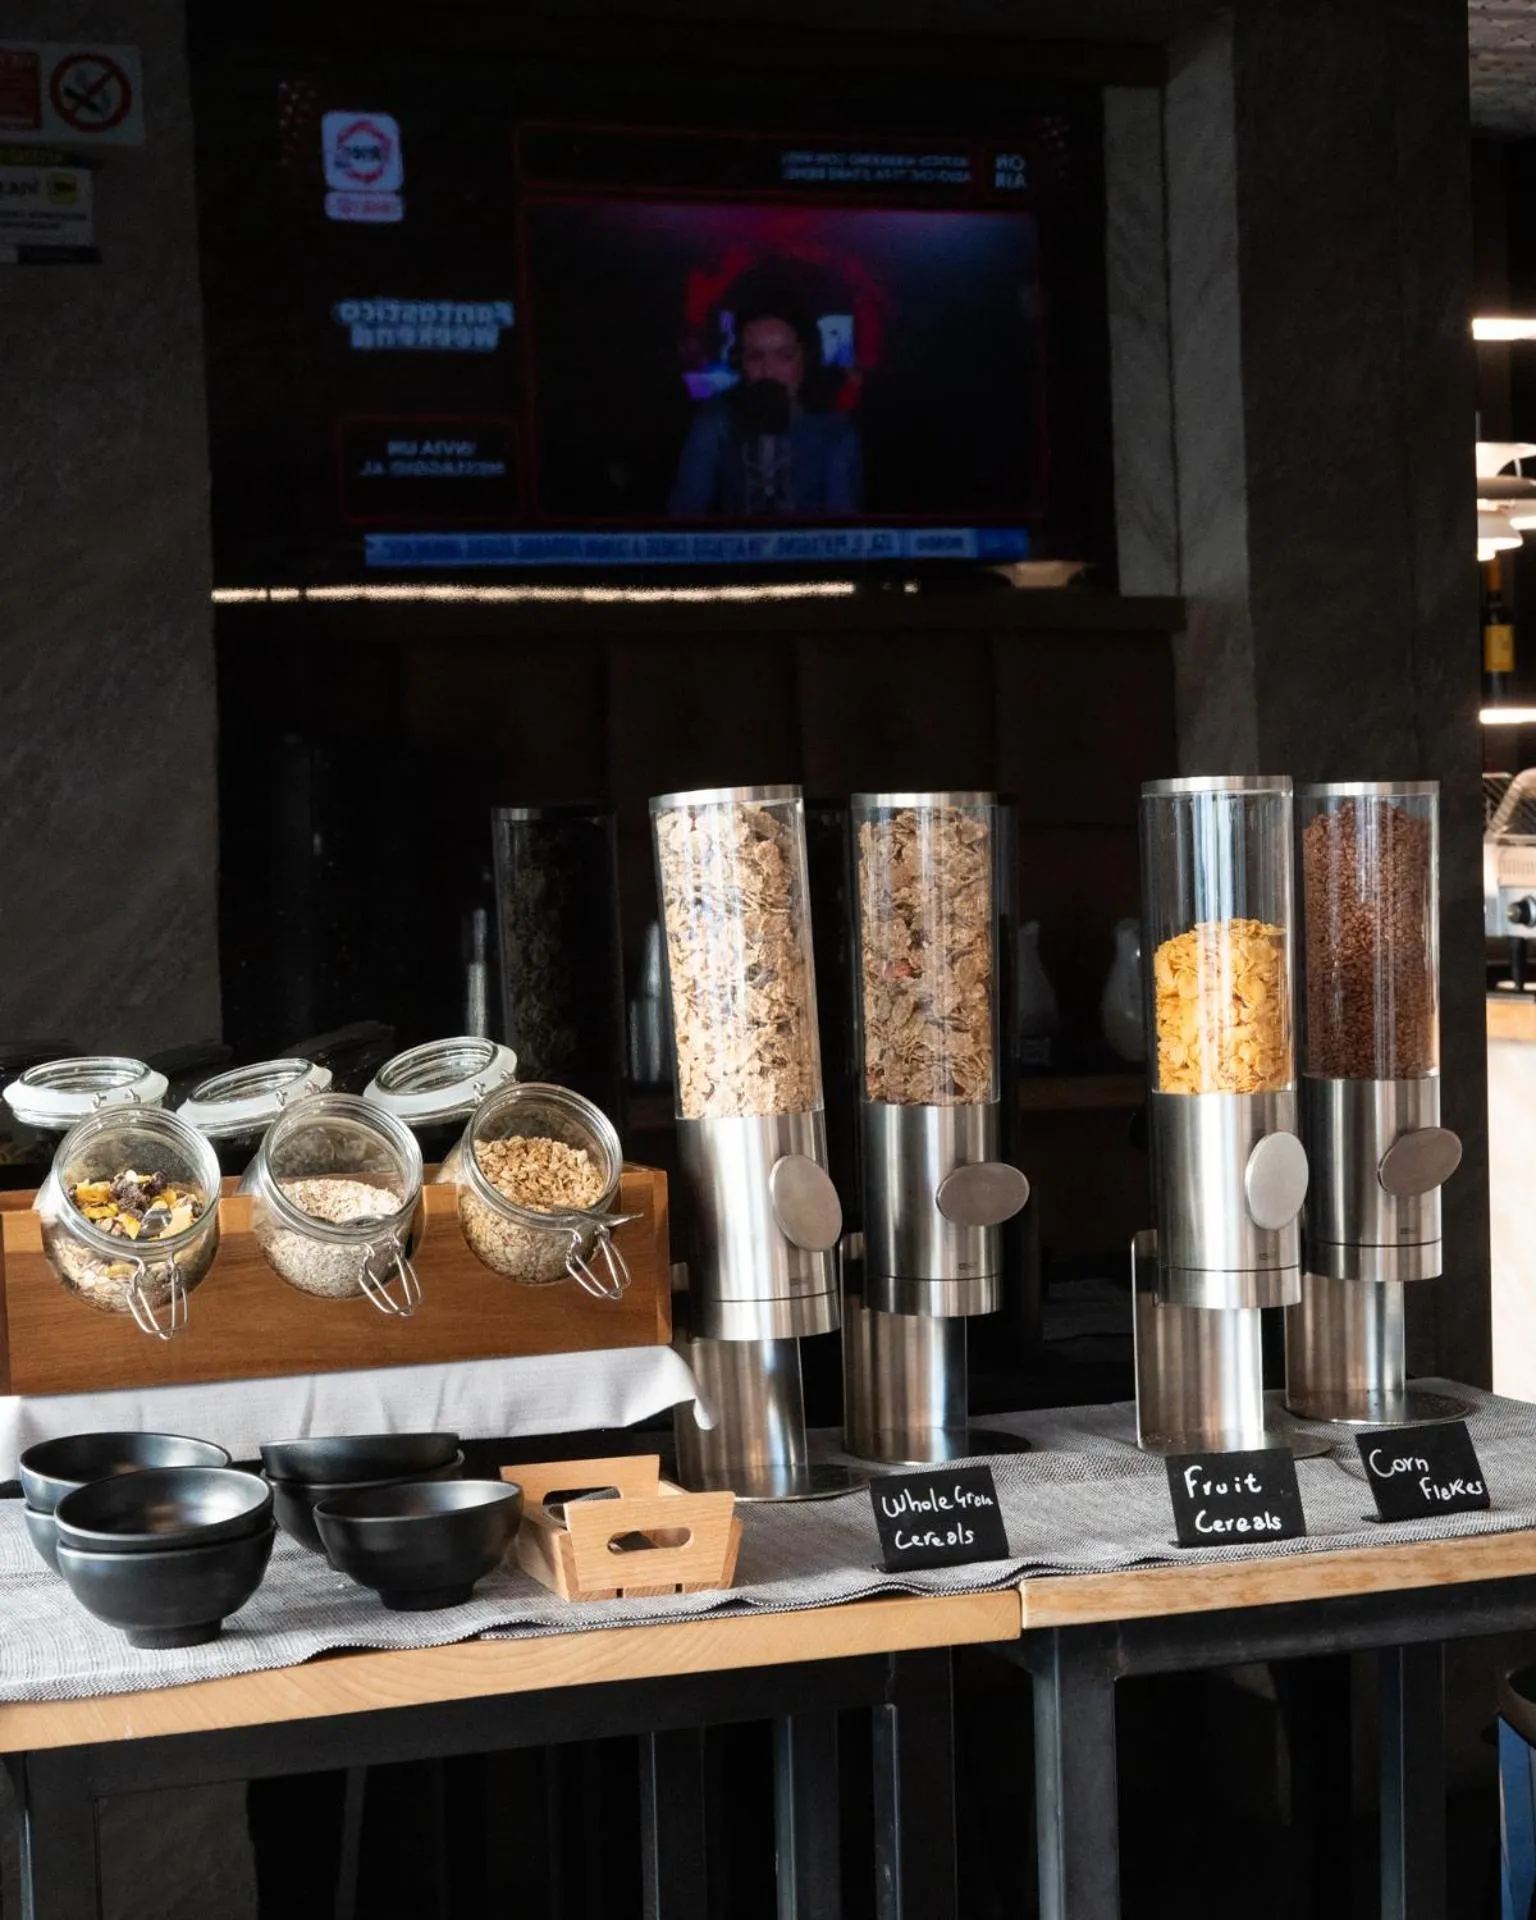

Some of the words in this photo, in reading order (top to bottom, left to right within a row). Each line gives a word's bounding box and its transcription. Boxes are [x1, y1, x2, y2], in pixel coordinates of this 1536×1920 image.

[1369, 1449, 1429, 1478] Corn
[1184, 1465, 1262, 1498] Fruit
[1419, 1477, 1483, 1500] Flakes
[882, 1488, 954, 1518] Whole
[1195, 1510, 1282, 1533] Cereals
[895, 1522, 975, 1550] Cereals
